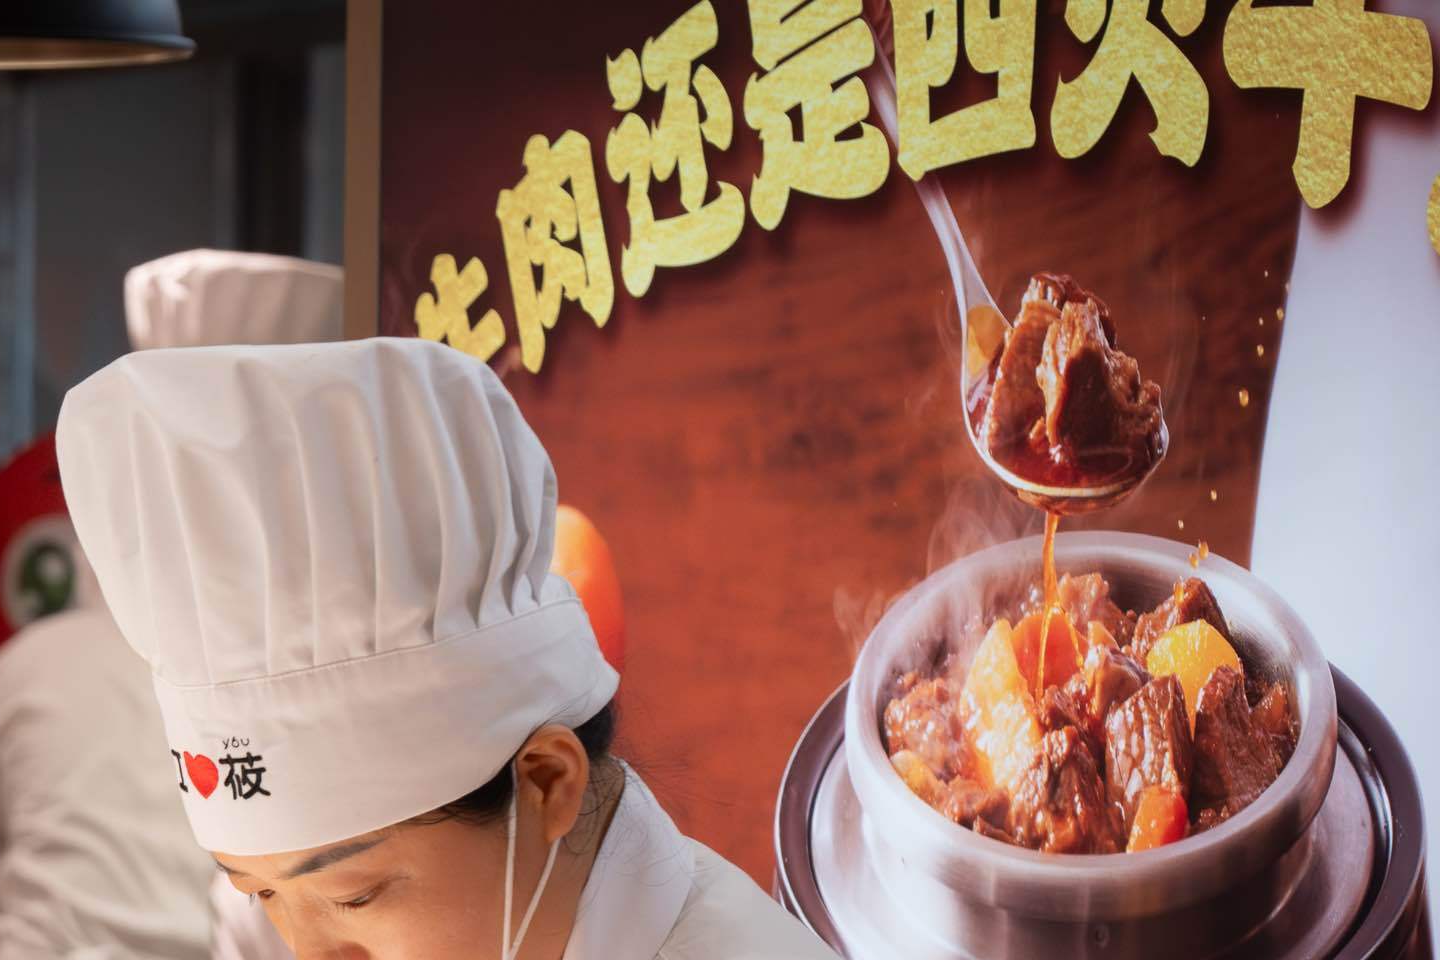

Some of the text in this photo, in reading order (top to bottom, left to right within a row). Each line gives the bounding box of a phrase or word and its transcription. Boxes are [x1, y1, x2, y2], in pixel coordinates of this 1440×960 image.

[414, 0, 1440, 373] 牛肉还是西贝牛
[218, 752, 271, 800] 莜
